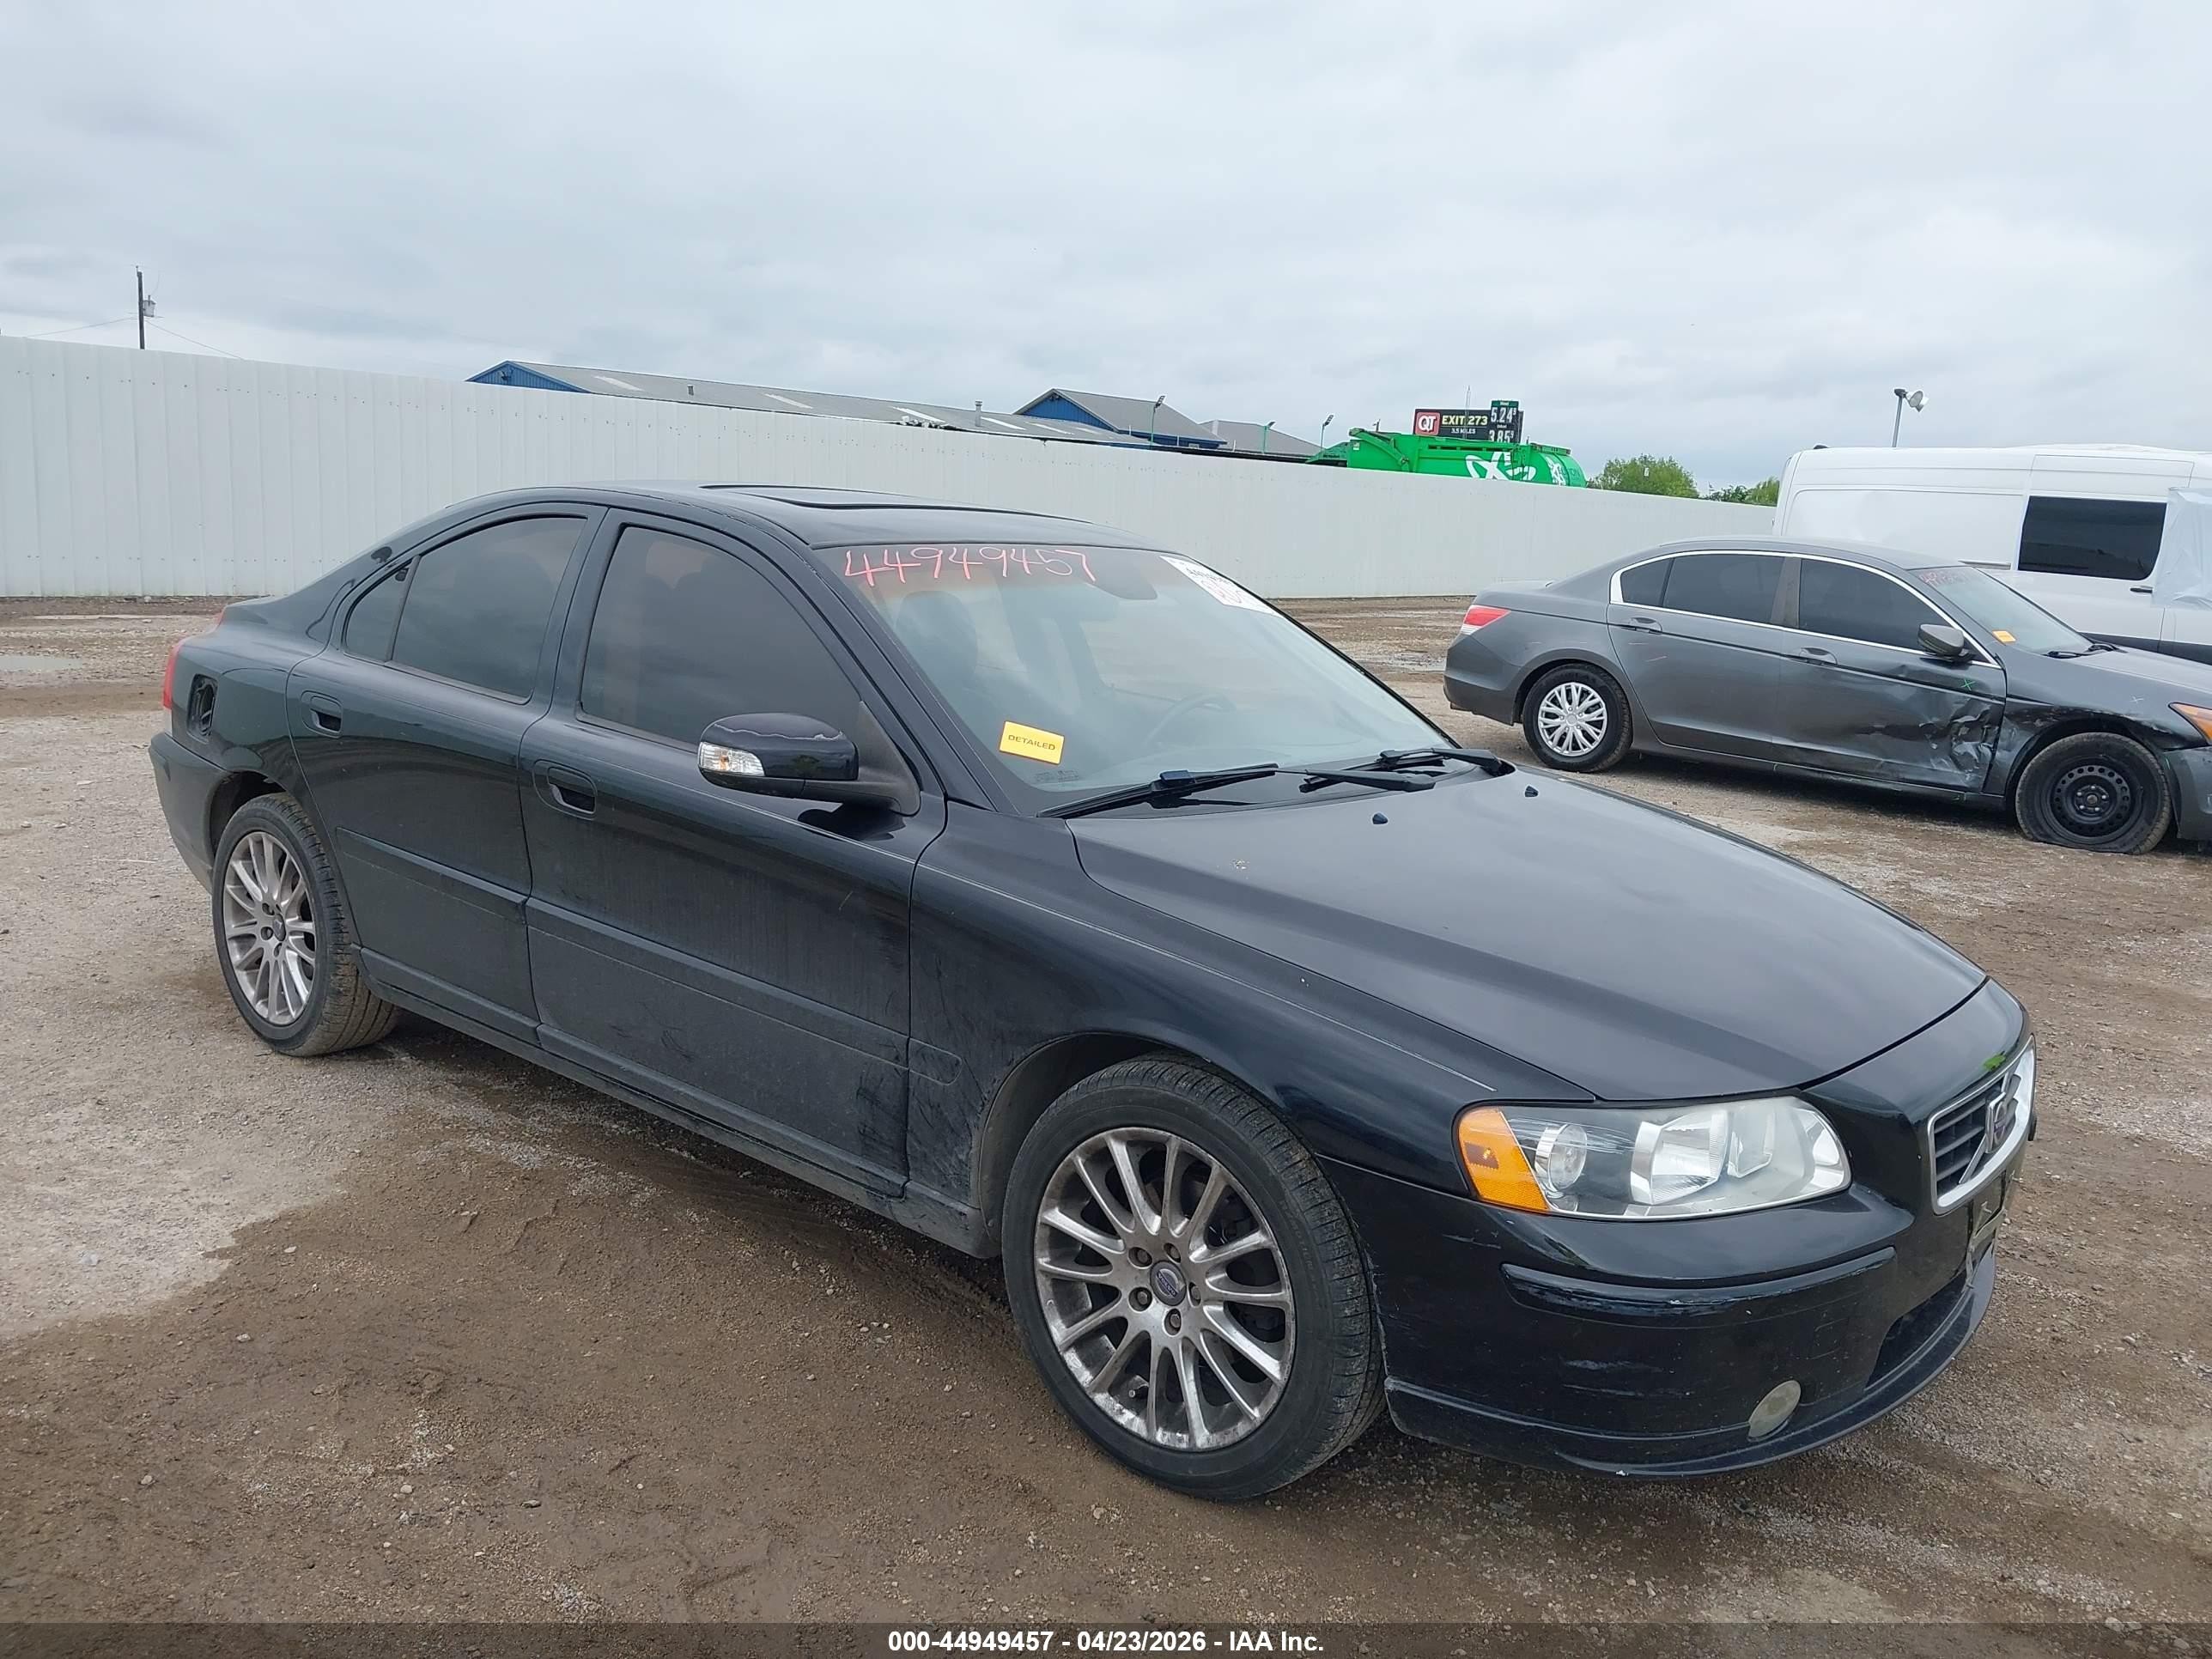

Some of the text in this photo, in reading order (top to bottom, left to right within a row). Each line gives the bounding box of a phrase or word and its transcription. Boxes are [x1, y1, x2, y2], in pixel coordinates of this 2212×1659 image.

[1418, 415, 1437, 432] QT
[1442, 415, 1488, 426] EXIT 273
[844, 546, 1097, 587] 44949457
[1008, 734, 1055, 750] DETAILED
